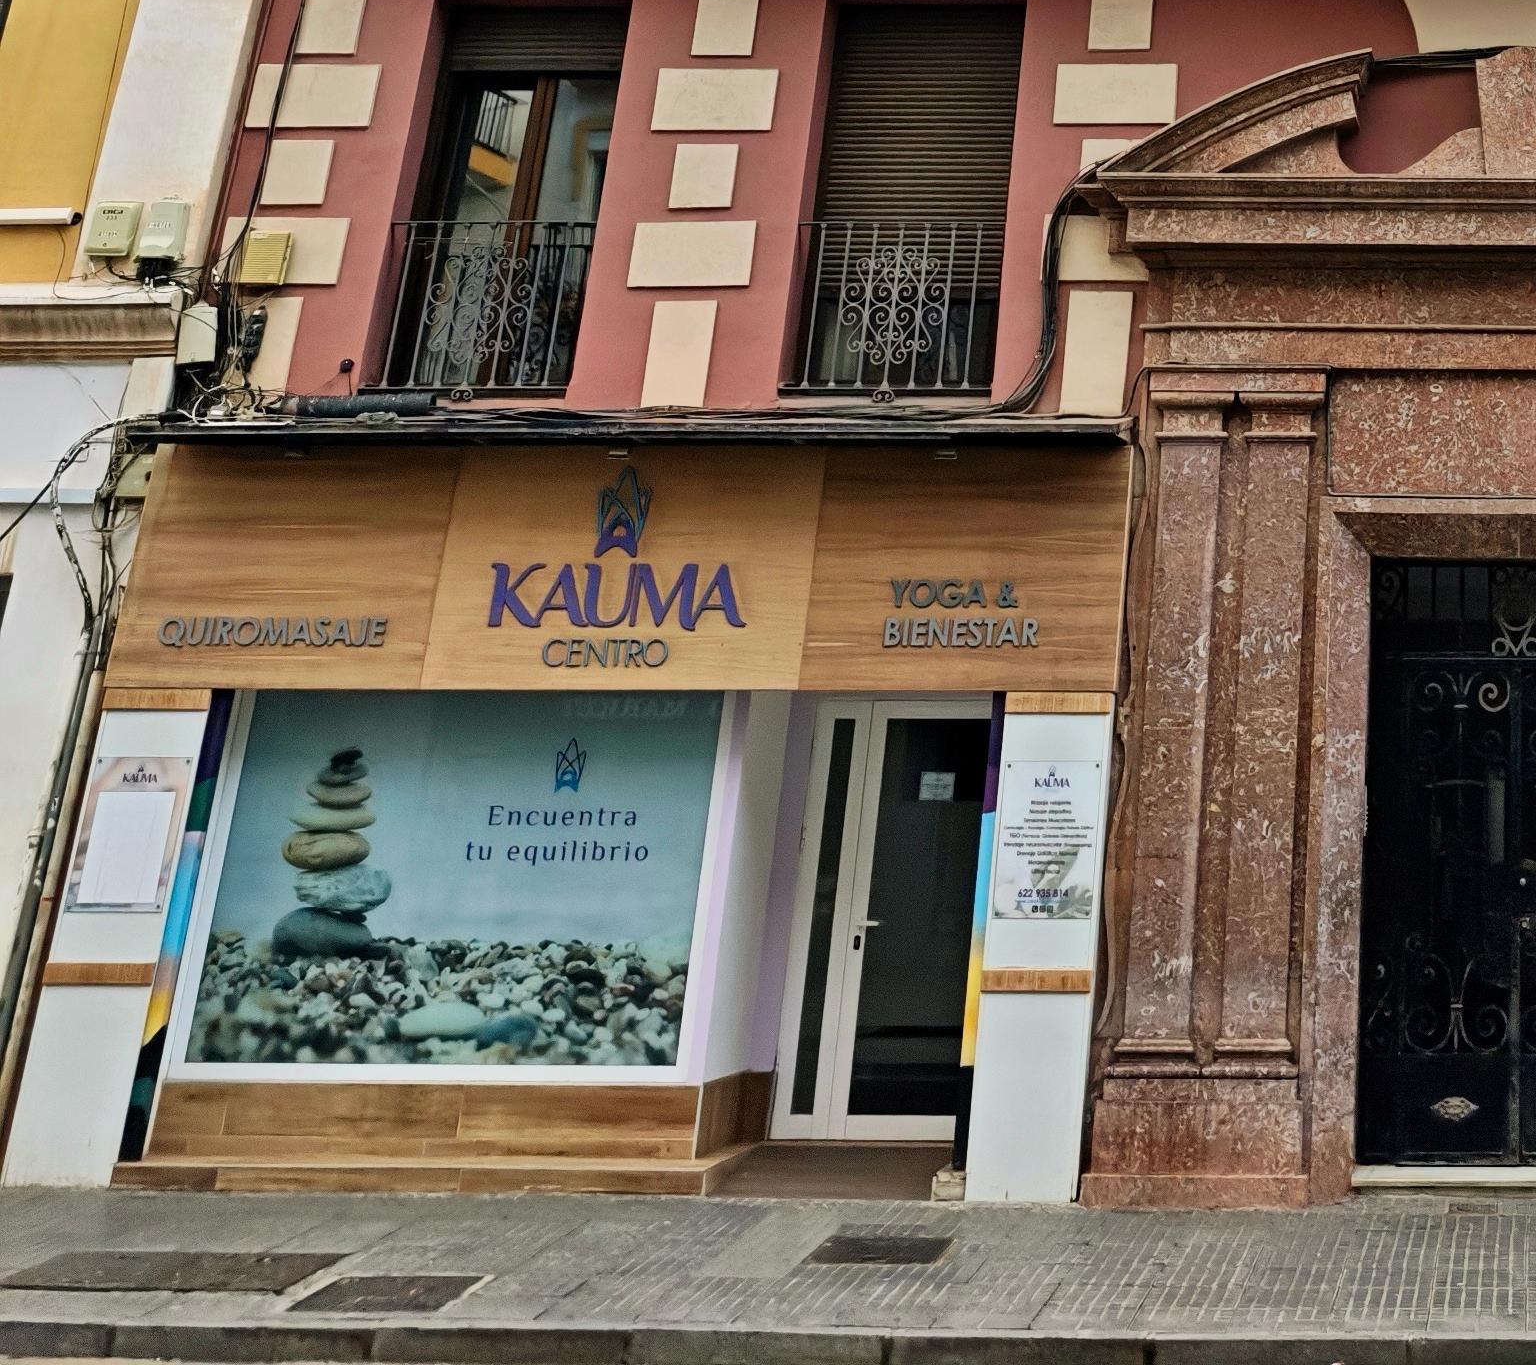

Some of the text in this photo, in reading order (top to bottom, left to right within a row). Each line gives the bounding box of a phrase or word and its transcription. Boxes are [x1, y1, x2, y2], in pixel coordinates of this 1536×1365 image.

[487, 562, 748, 632] KAUMA
[891, 579, 1019, 609] YOGA &
[158, 616, 388, 648] QUIROMASAJE
[882, 617, 1040, 648] BIENESTAR
[541, 638, 669, 668] CENTRO
[1034, 777, 1070, 788] KAUMA
[488, 805, 638, 827] Encuentra
[466, 840, 649, 866] tu equilibrio
[1018, 888, 1069, 898] 622 935 814
